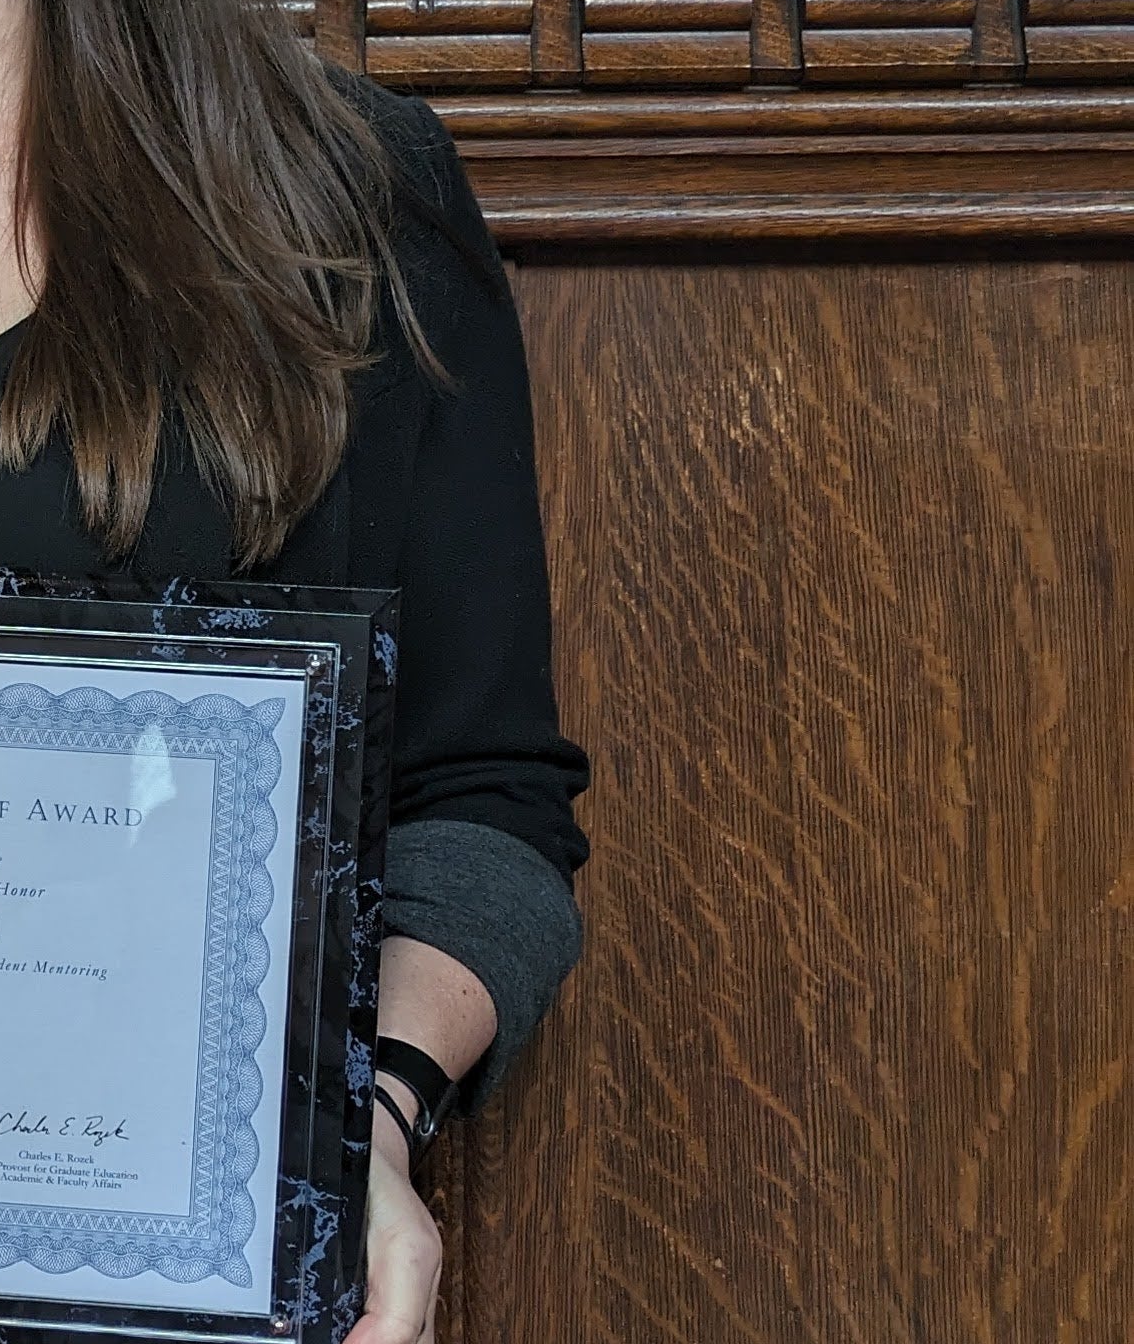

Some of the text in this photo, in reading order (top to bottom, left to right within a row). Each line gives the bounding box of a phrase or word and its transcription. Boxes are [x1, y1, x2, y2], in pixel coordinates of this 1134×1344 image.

[27, 799, 143, 828] AWARD
[34, 960, 108, 980] Mentoring
[19, 1150, 94, 1164] Charles E. Rozek
[34, 1164, 47, 1174] for
[49, 1167, 90, 1177] Graduate
[94, 1168, 138, 1179] Education
[1, 1173, 42, 1184] Academic
[46, 1176, 54, 1184] &
[57, 1177, 88, 1190] Faculty
[92, 1179, 122, 1189] Affairs
